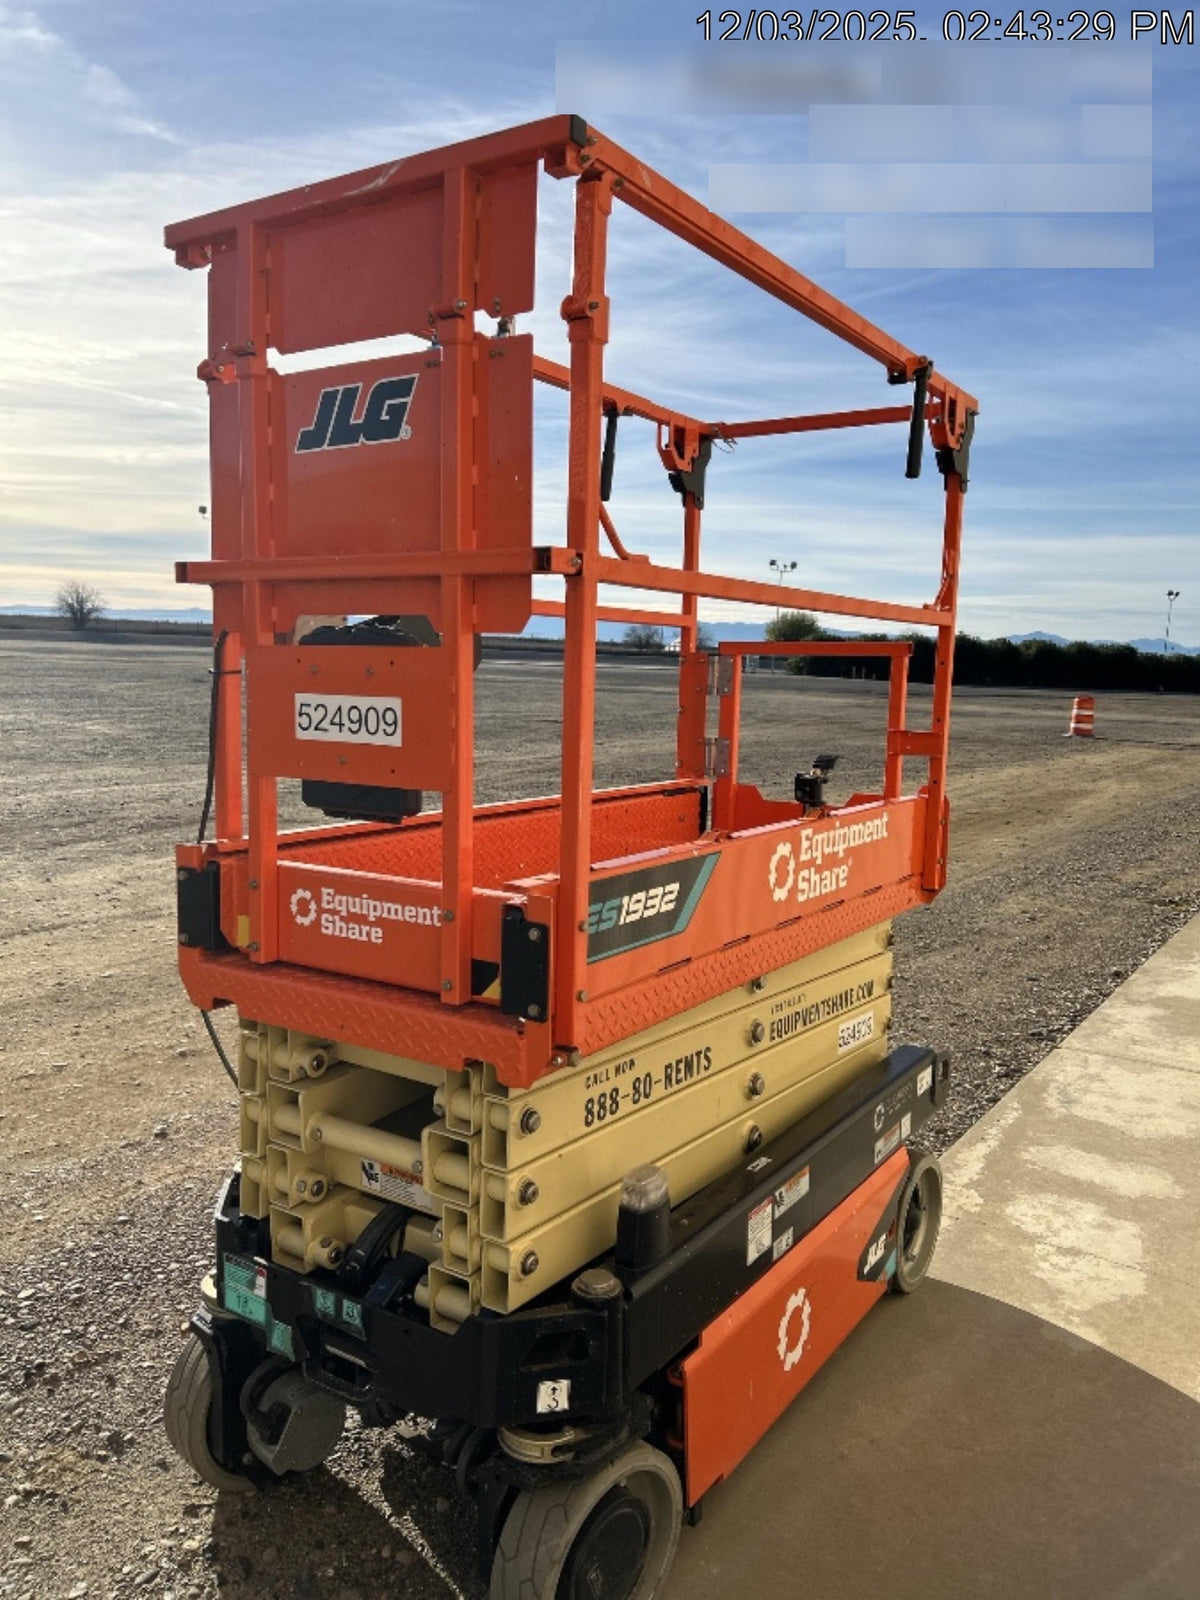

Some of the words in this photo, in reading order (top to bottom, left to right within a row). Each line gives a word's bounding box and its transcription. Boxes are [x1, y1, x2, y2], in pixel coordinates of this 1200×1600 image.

[295, 373, 419, 454] JLG
[298, 703, 398, 737] 524909
[800, 812, 888, 865] Equipment
[797, 864, 848, 903] Share
[321, 886, 442, 927] Equipment
[321, 913, 384, 944] Share
[584, 1046, 712, 1128] 888-80-RENTS
[585, 1067, 611, 1090] CALL
